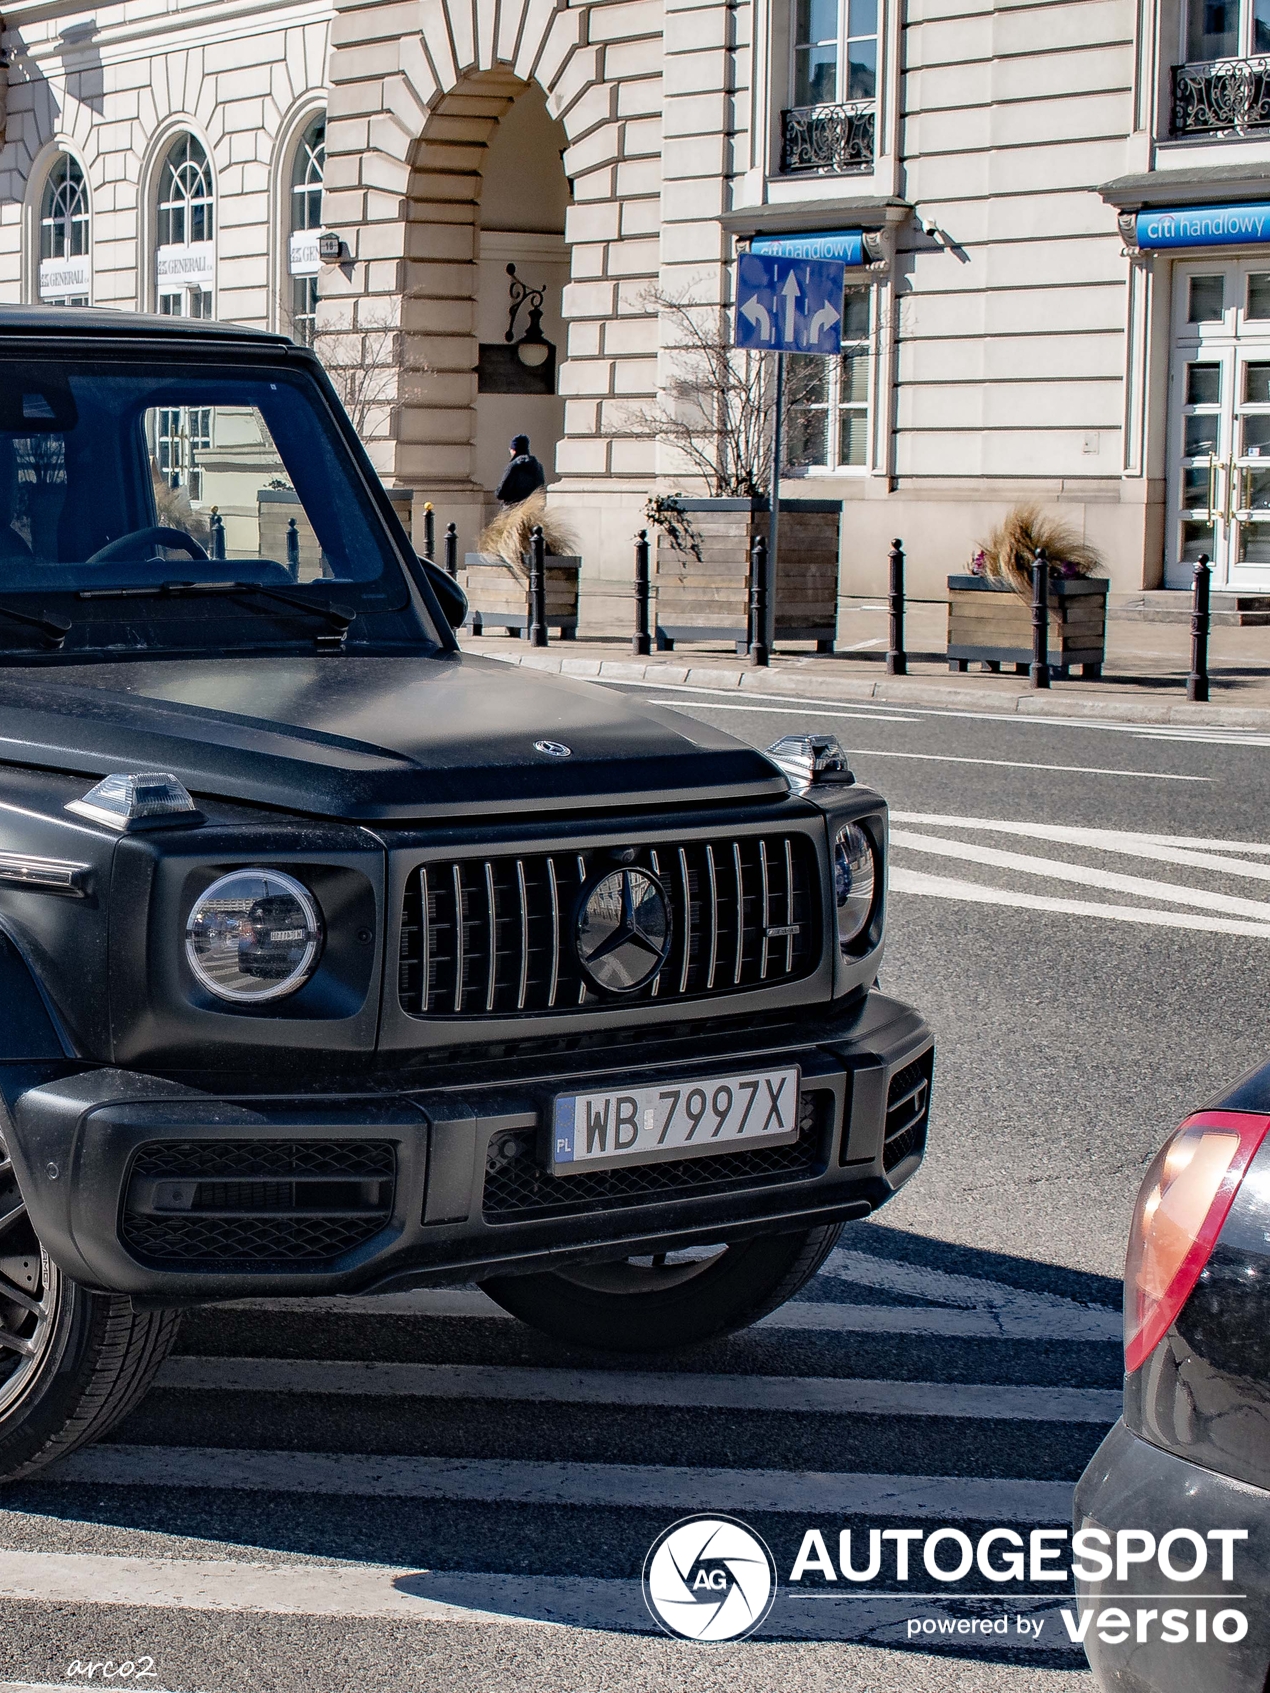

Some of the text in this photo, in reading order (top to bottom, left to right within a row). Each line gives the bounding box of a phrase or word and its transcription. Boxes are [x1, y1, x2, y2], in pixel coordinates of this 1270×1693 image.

[1148, 213, 1265, 239] citi handlowy
[786, 240, 854, 260] handlowy
[167, 256, 206, 274] GENERALI
[50, 270, 84, 287] GENERALI
[586, 1077, 787, 1153] WB 7997X
[557, 1138, 571, 1153] PL
